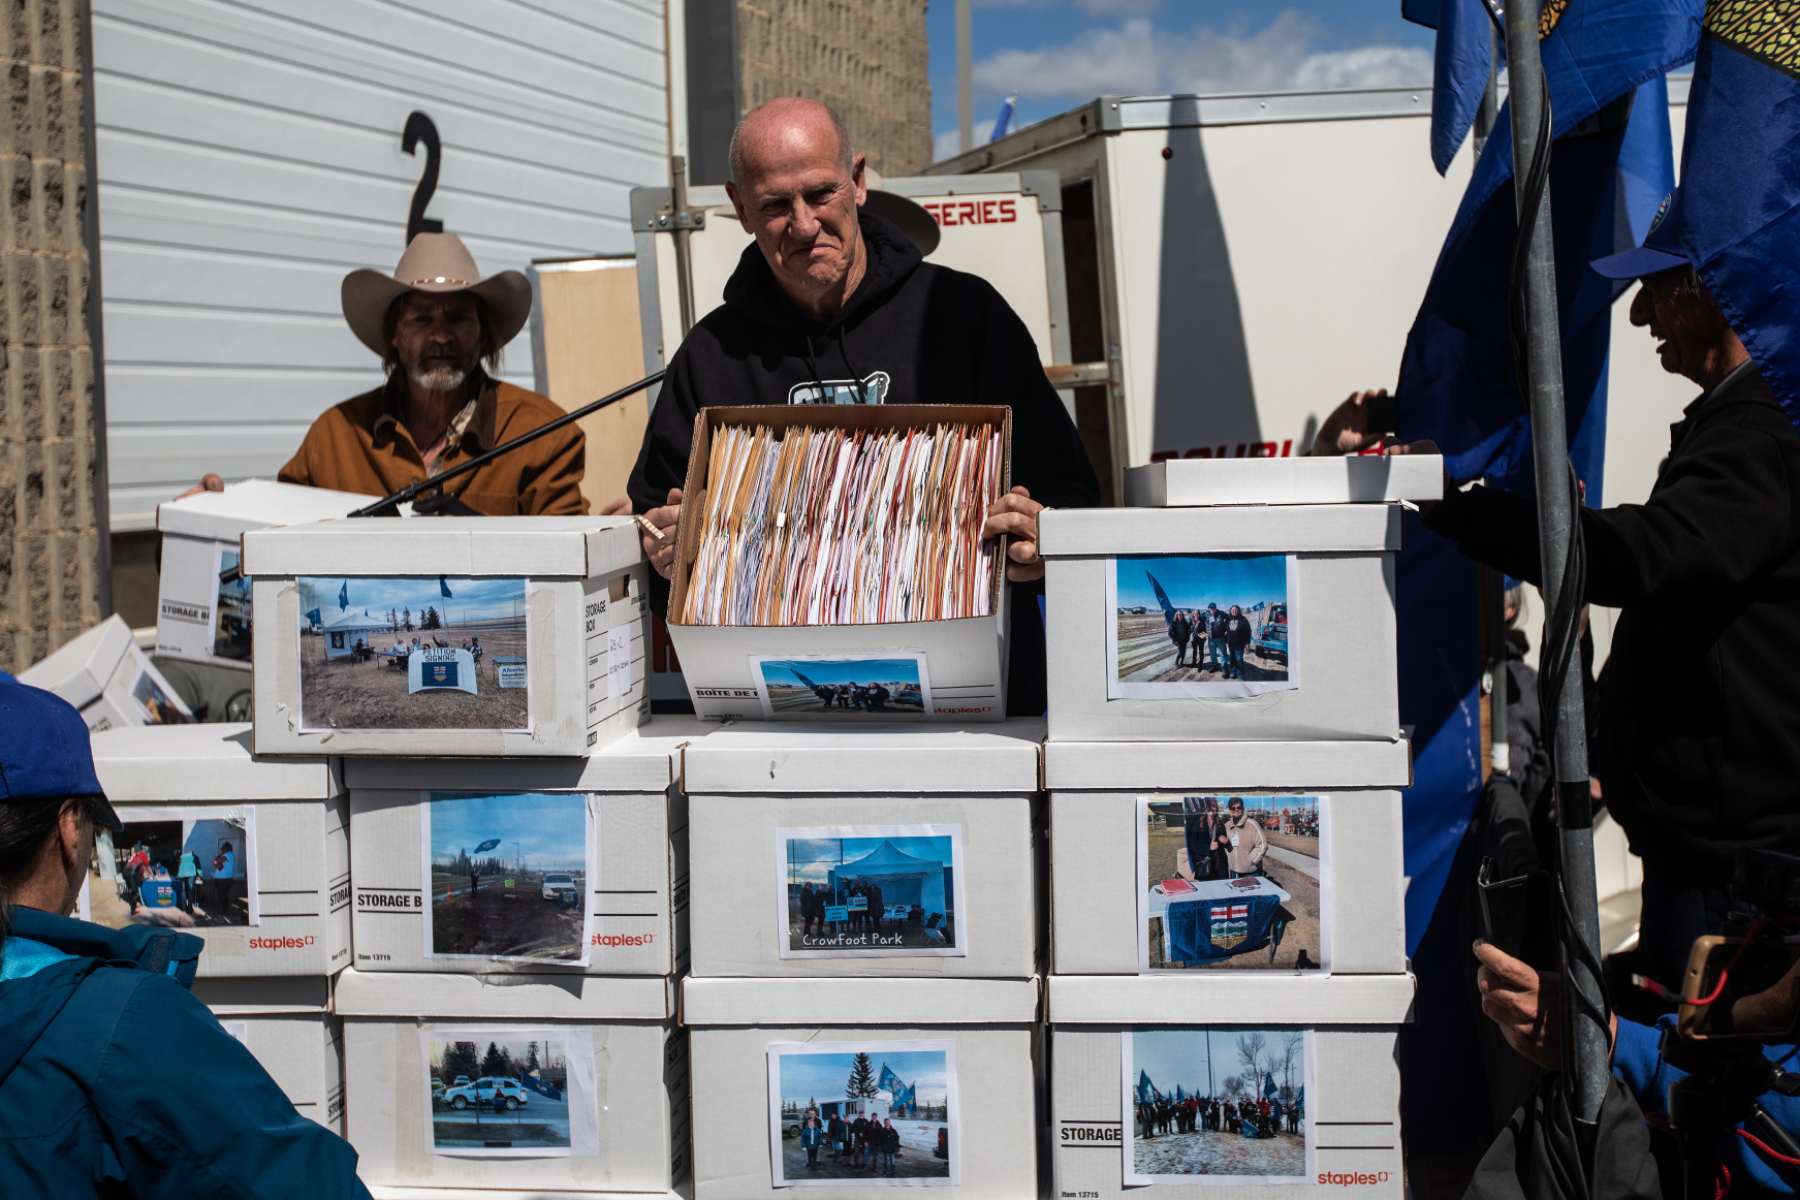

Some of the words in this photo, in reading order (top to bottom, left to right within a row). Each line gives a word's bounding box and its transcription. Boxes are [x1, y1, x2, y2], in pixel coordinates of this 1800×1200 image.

[402, 110, 442, 248] 2
[162, 604, 199, 619] STORAGE
[585, 600, 606, 618] STORAGE
[357, 894, 411, 907] STORAGE
[249, 936, 305, 950] staples
[592, 933, 643, 947] staples
[802, 932, 868, 946] Crowfoot
[871, 932, 903, 946] Park
[1060, 1127, 1122, 1141] STORAGE
[1317, 1170, 1377, 1187] staples
